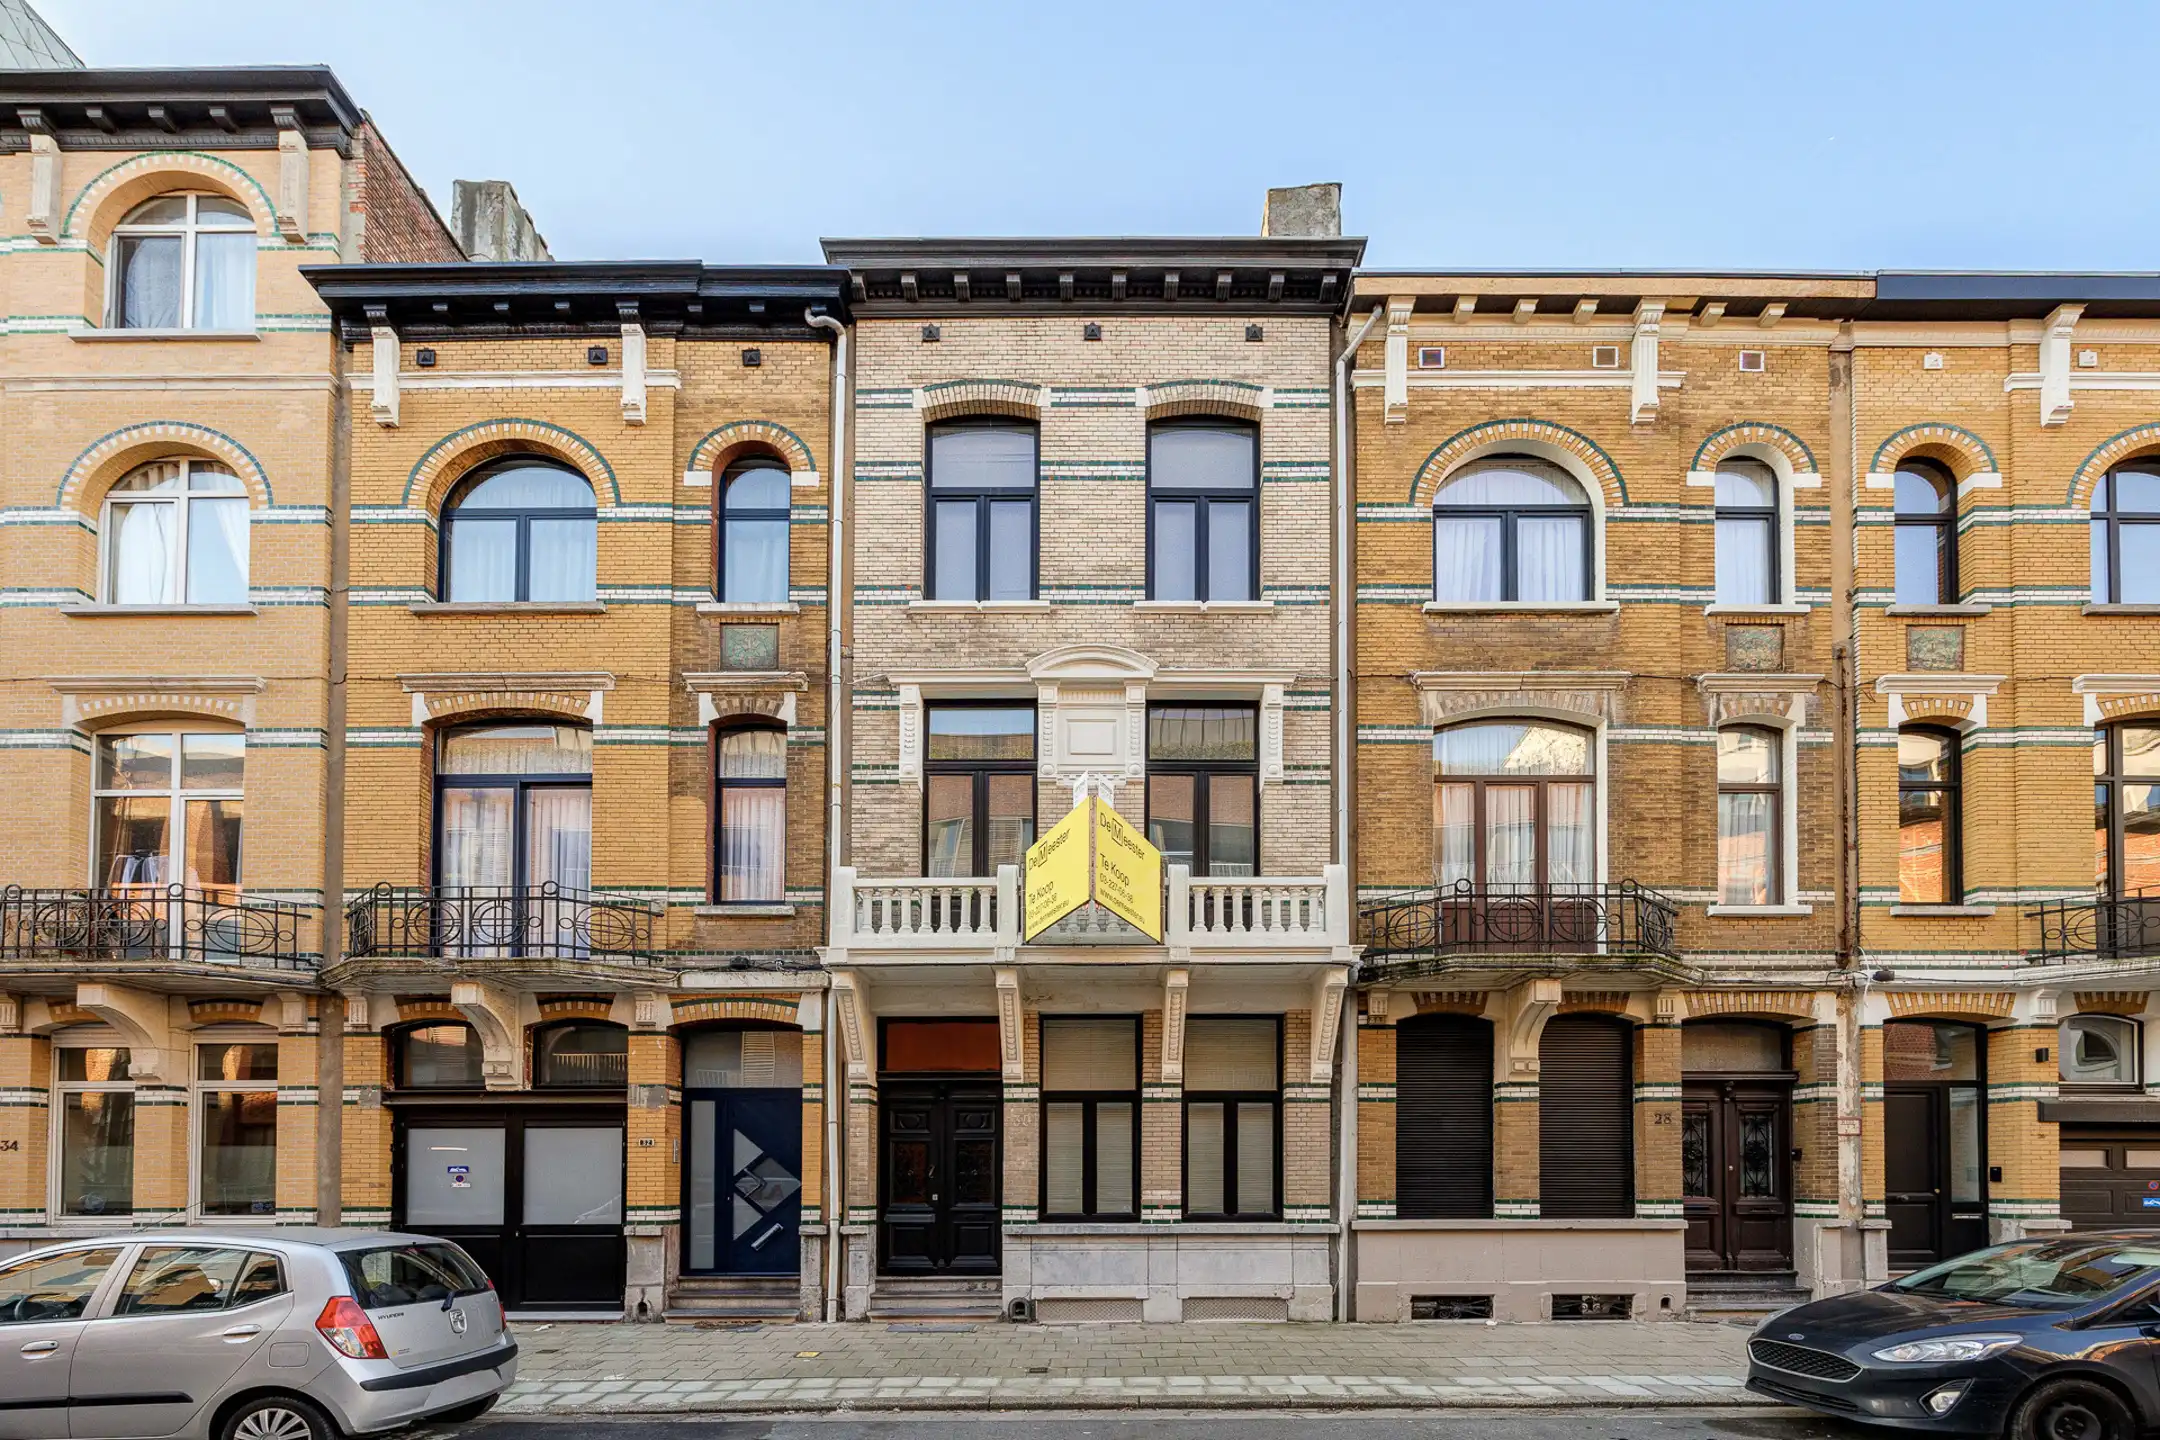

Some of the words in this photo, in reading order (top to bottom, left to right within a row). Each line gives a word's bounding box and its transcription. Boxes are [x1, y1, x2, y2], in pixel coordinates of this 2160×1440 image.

[1100, 812, 1111, 833] De
[1111, 818, 1146, 861] Meester
[1028, 856, 1038, 871] De
[1100, 853, 1109, 871] Te
[1110, 860, 1130, 887] Koop
[1036, 881, 1054, 901] Koop
[1654, 1113, 1672, 1125] 28
[0, 1140, 18, 1151] 34
